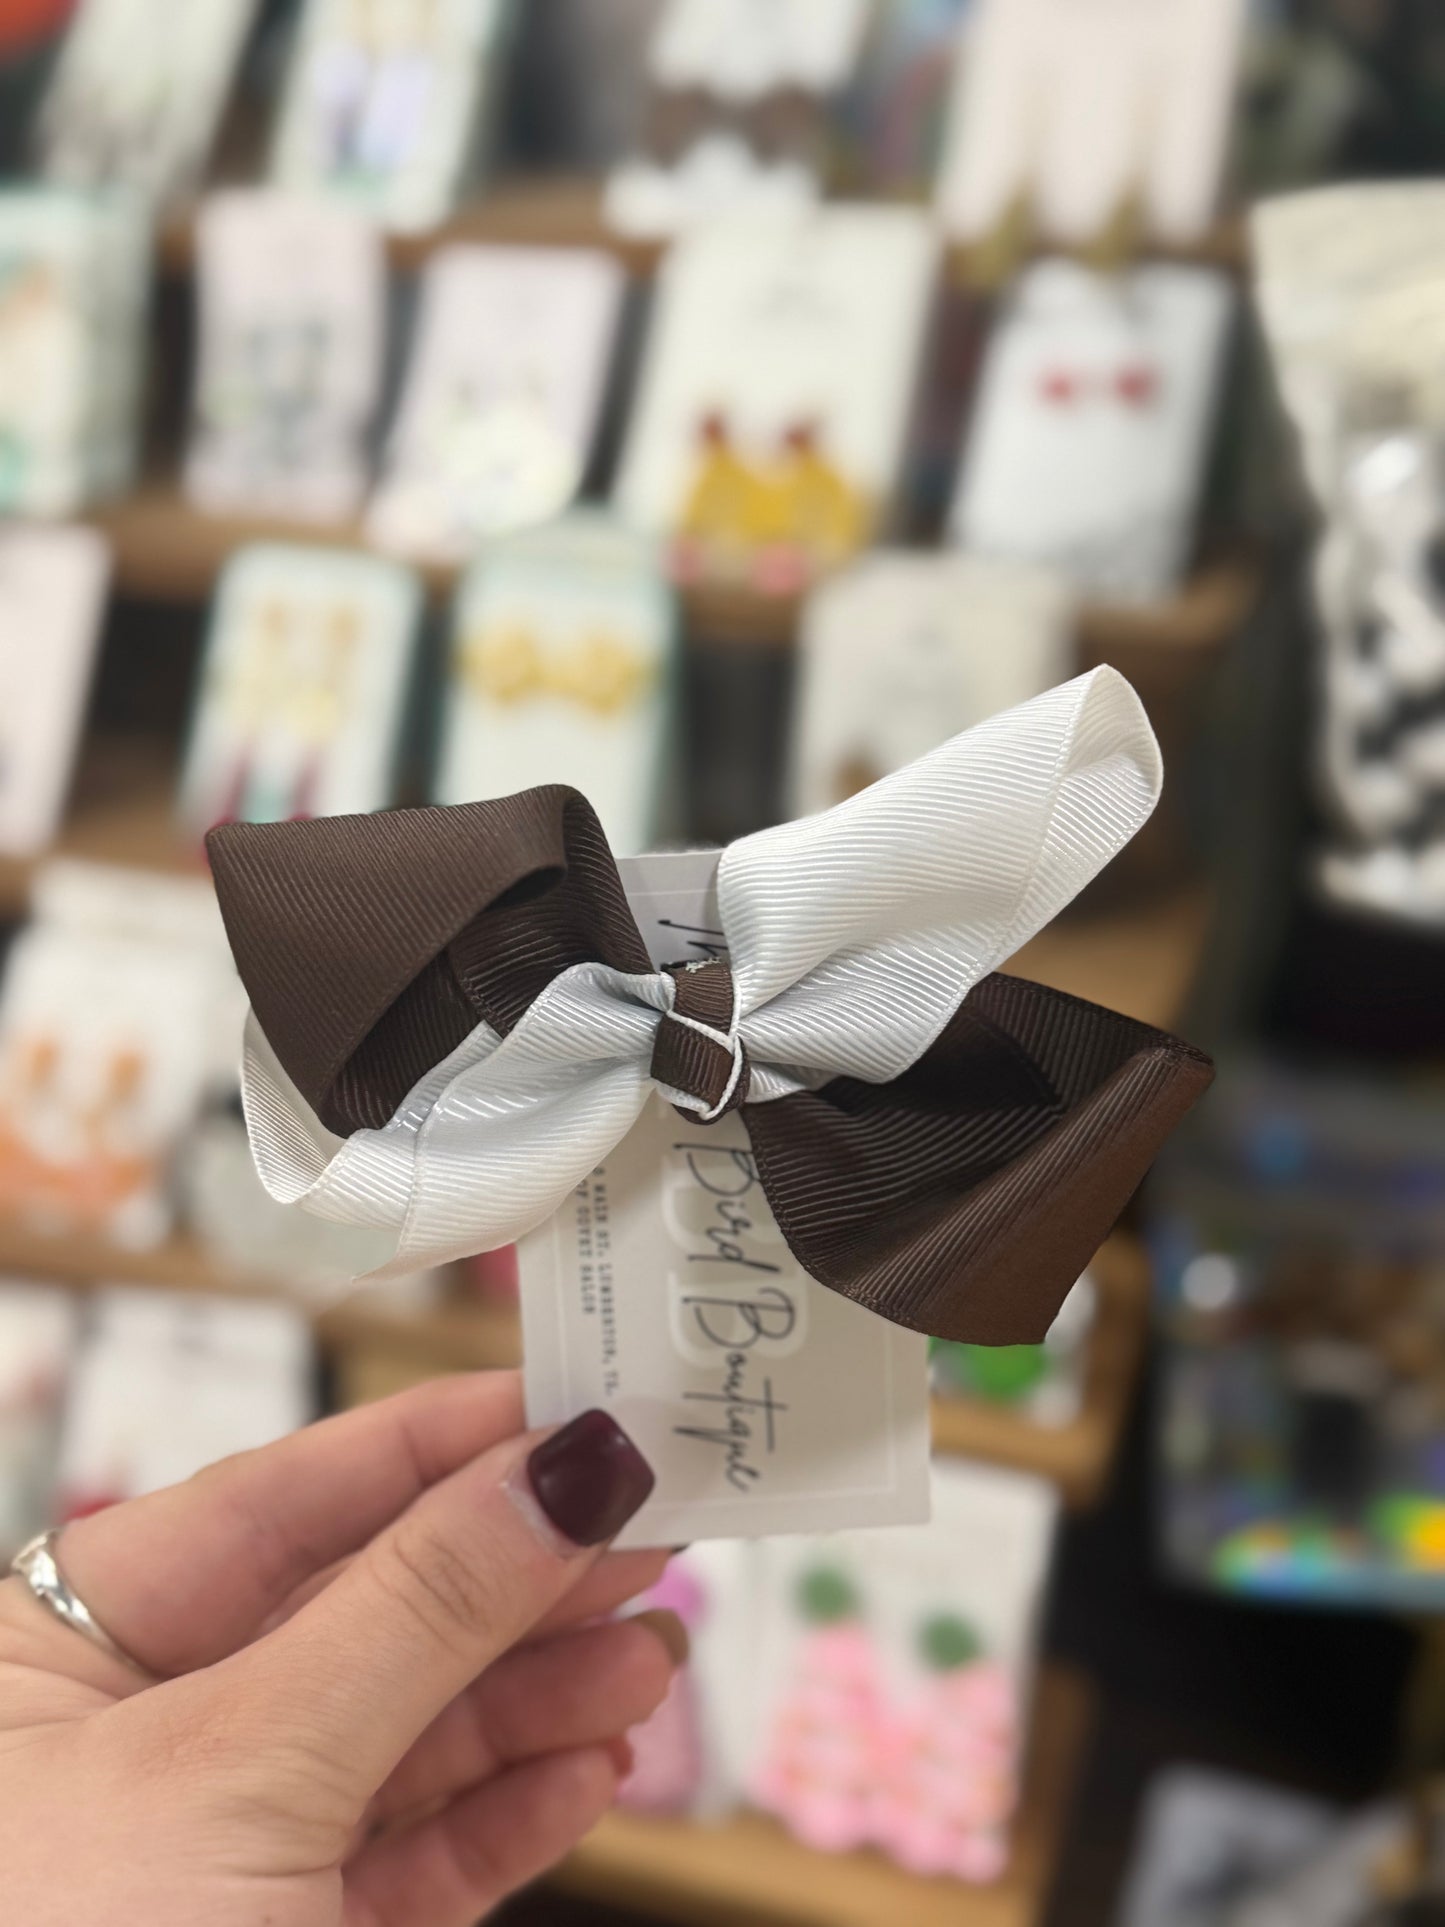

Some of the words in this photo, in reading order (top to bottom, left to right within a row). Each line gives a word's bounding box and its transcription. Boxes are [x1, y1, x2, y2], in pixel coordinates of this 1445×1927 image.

[592, 1184, 608, 1223] MAIN
[672, 1143, 781, 1273] Bird
[671, 1286, 796, 1493] Boutique
